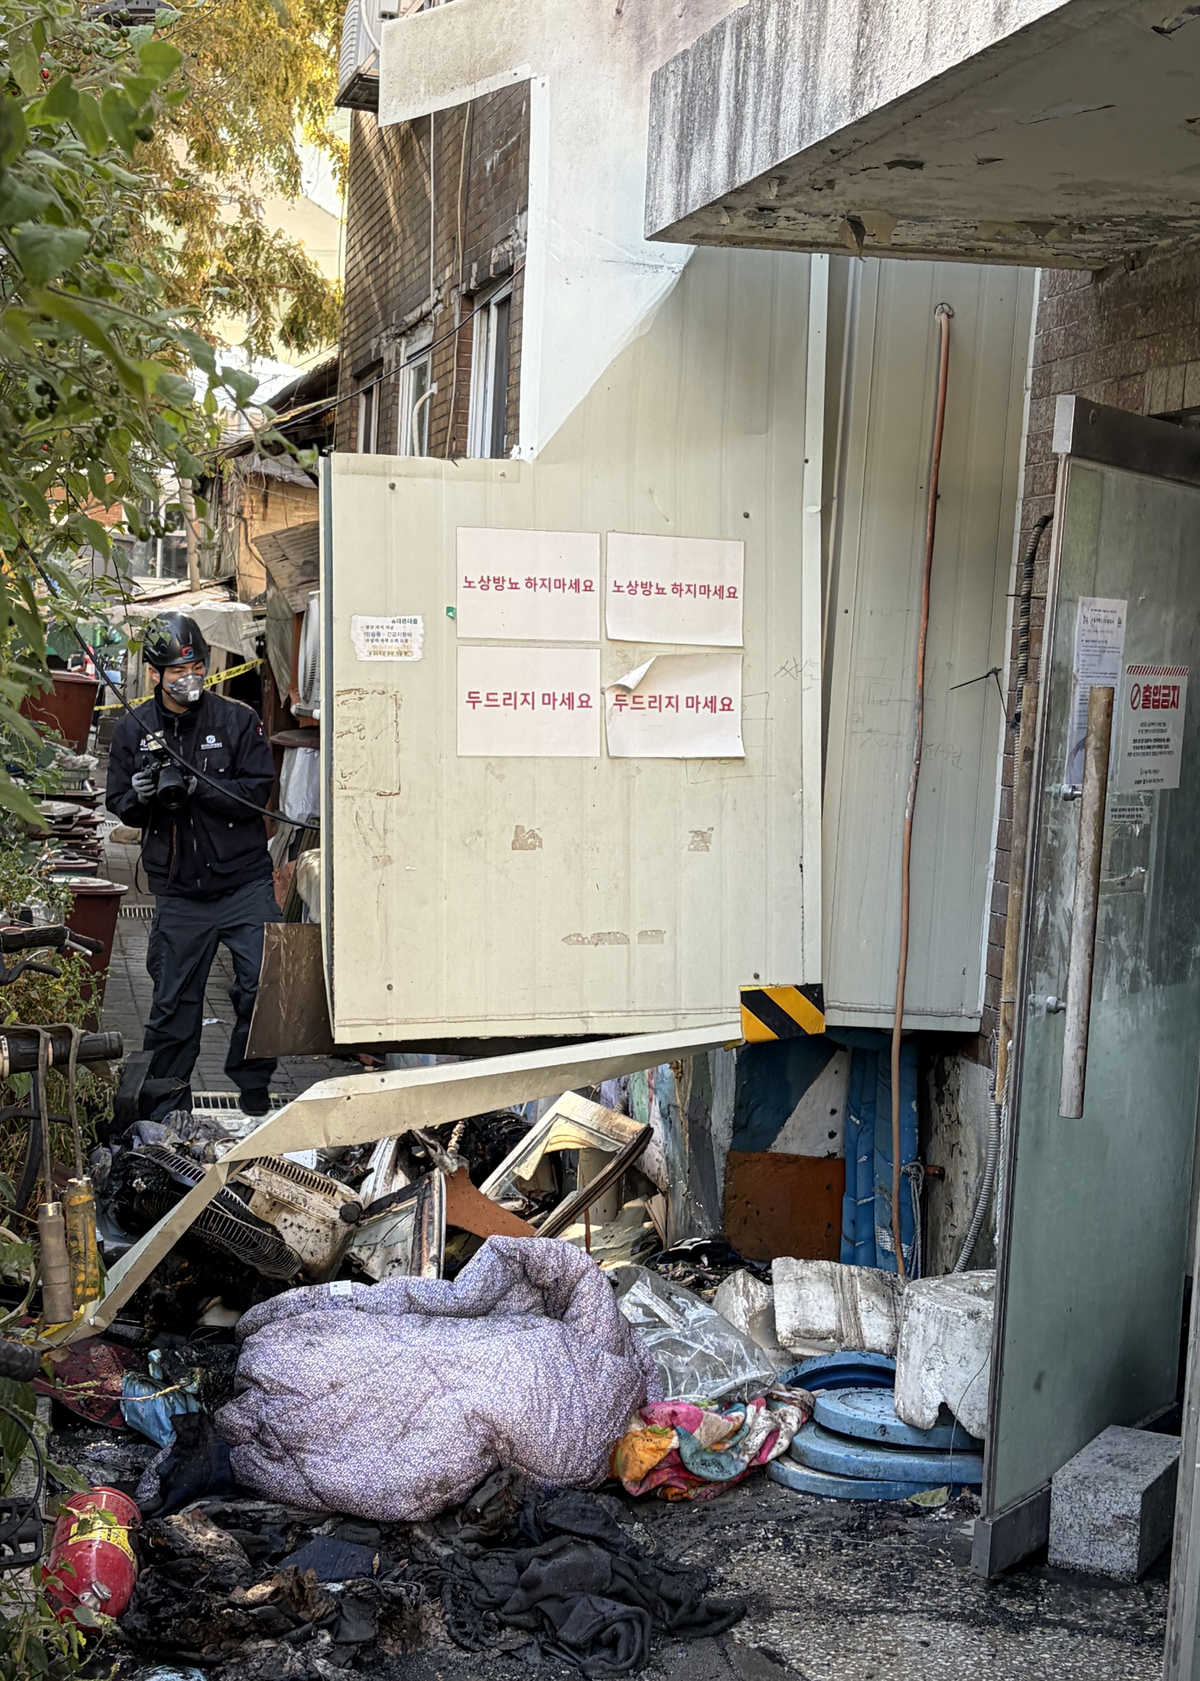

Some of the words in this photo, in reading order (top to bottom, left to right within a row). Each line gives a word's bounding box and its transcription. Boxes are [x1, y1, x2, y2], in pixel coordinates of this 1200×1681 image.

[463, 575, 521, 593] 노상방뇨
[524, 576, 595, 594] 하지마세요
[612, 579, 668, 597] 노상방뇨
[670, 582, 739, 600] 하지마세요
[465, 690, 536, 711] 두드리지
[541, 690, 593, 711] 마세요
[612, 692, 680, 713] 두드리지
[685, 694, 735, 714] 마세요
[1141, 683, 1180, 710] 출입금지
